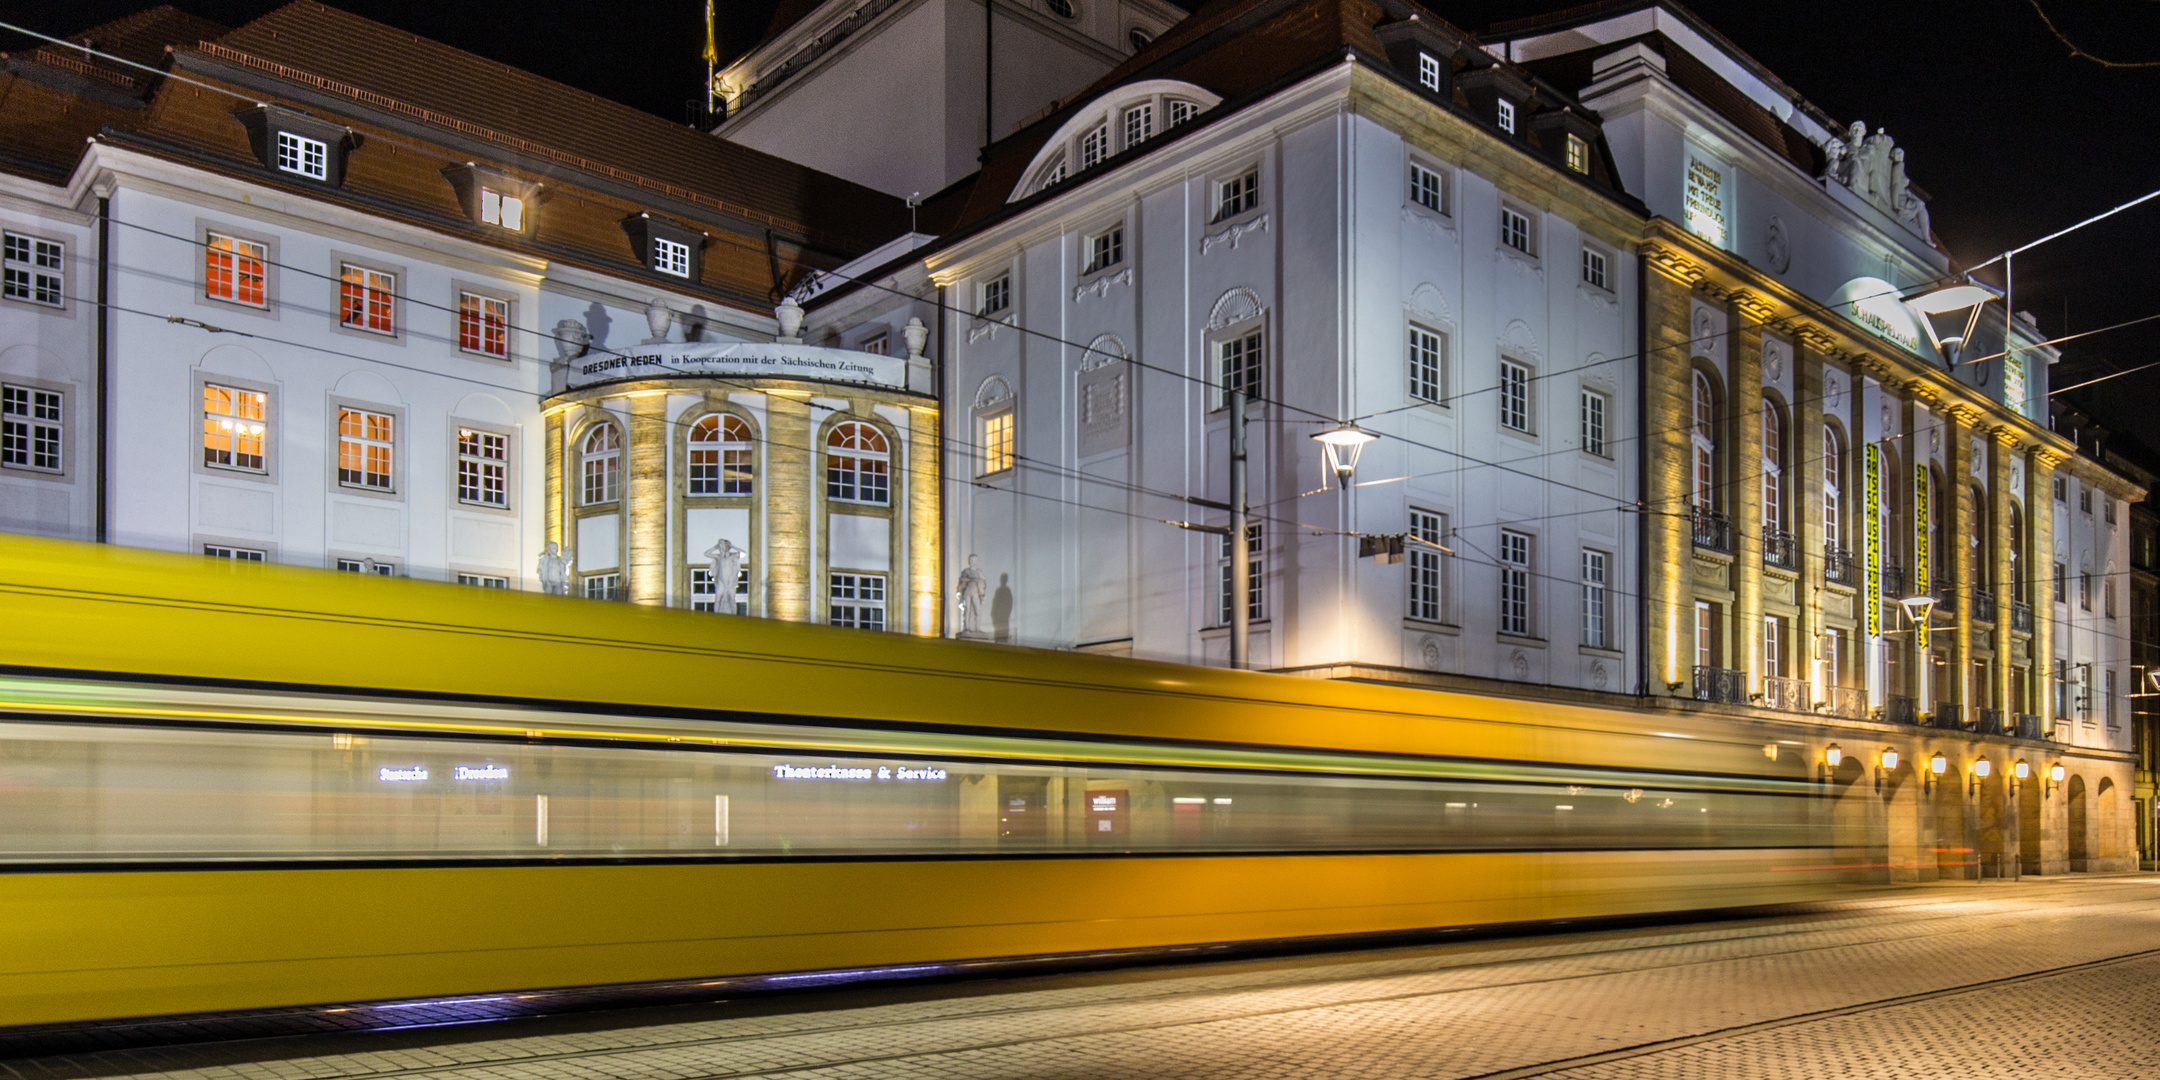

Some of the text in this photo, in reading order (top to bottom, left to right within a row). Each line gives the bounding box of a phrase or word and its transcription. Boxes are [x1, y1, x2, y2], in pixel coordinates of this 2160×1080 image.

[1851, 301, 1917, 350] SCHAUSPIELHAUS
[582, 354, 874, 375] DRESDNER REDEN in Kooperation mit der Sächsischen Zeitung
[459, 765, 508, 779] Dresden
[773, 764, 946, 779] Theaterkasse & Service
